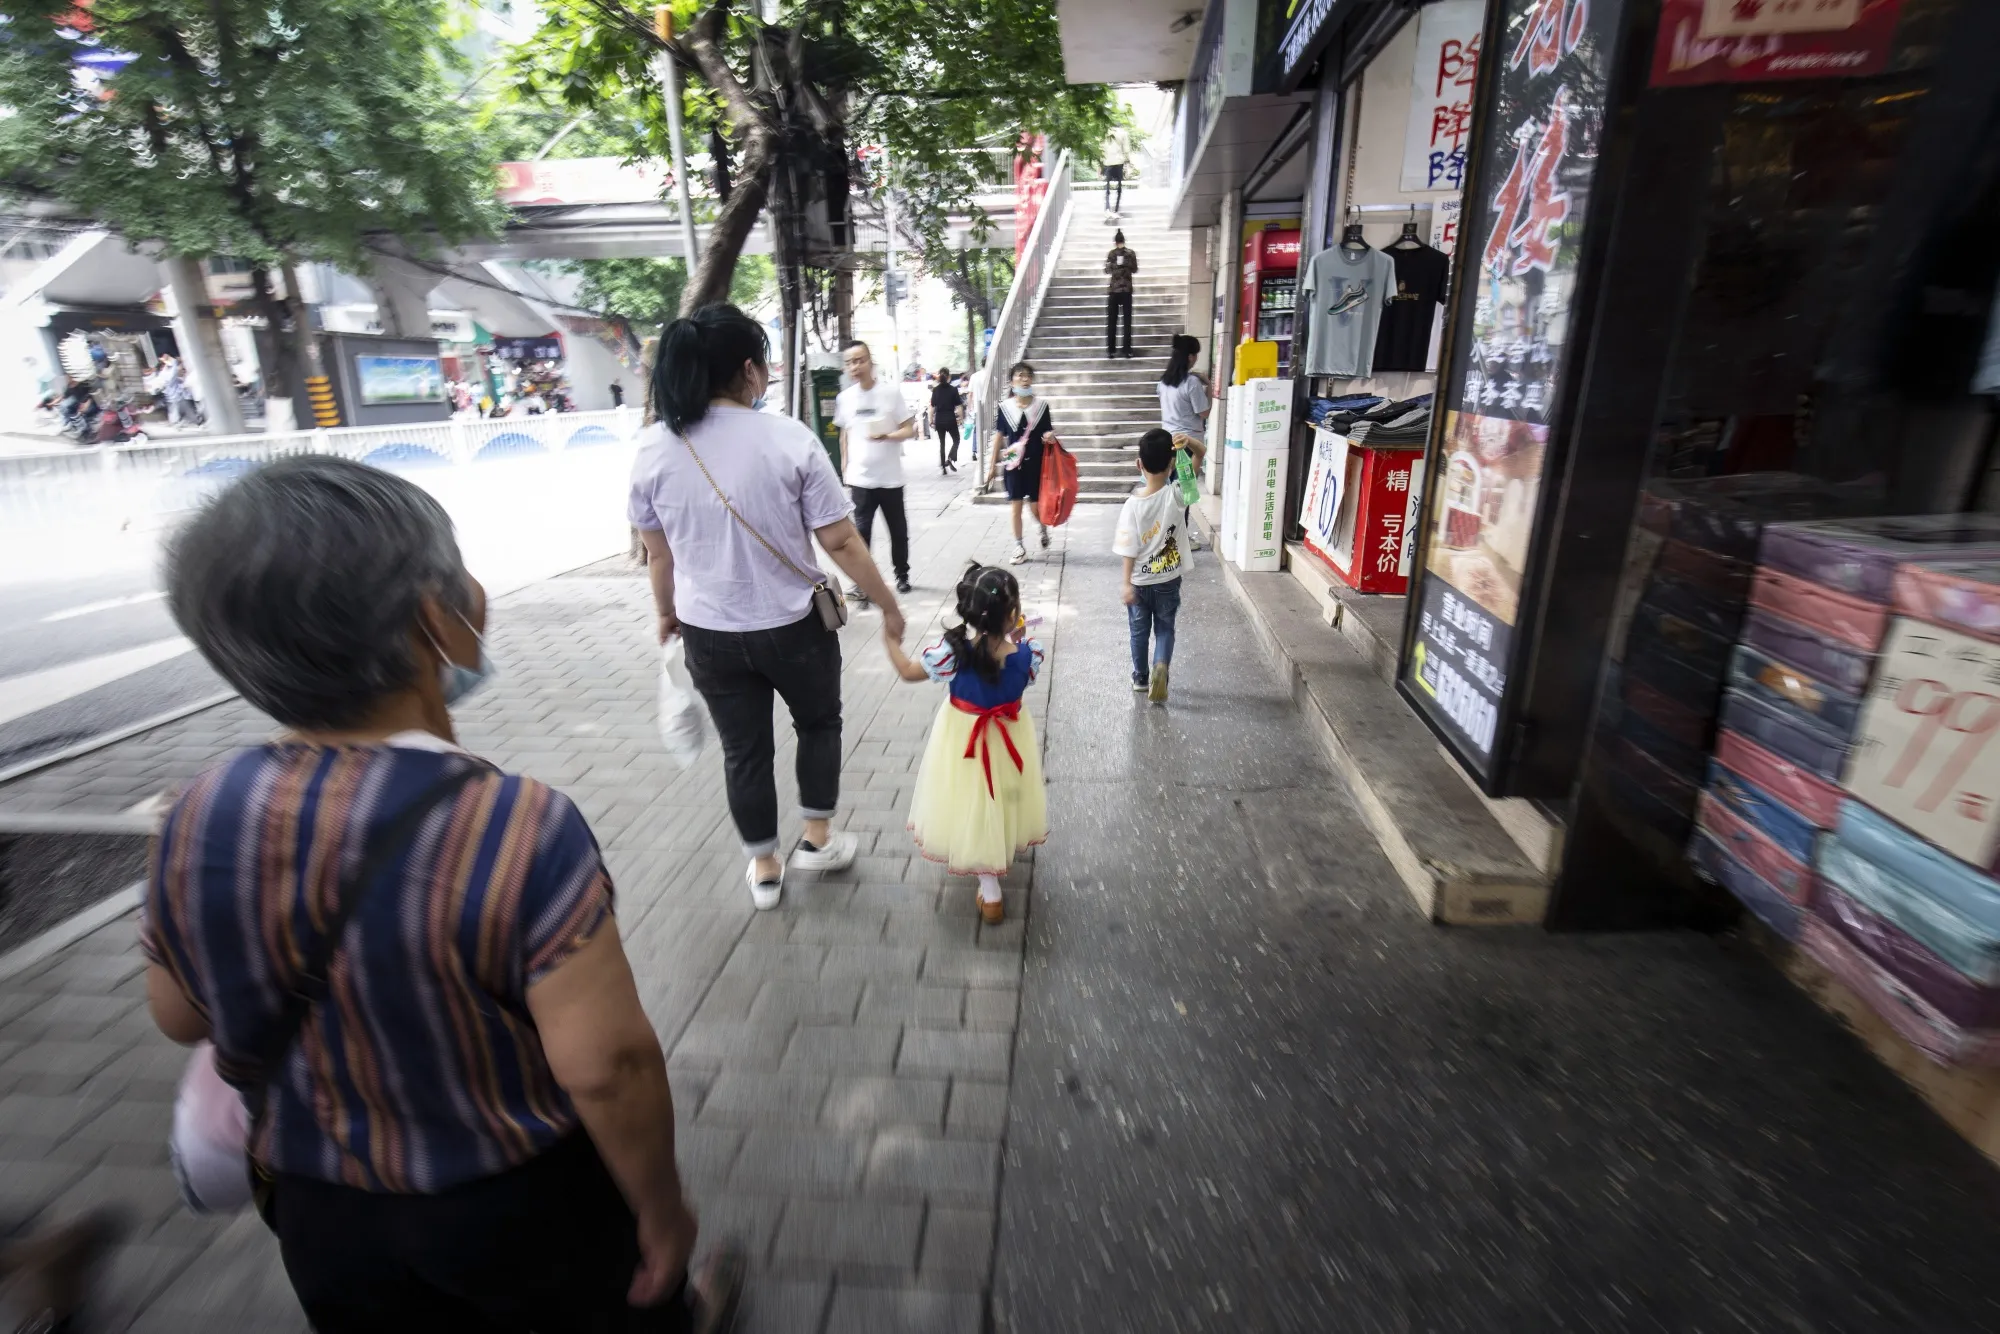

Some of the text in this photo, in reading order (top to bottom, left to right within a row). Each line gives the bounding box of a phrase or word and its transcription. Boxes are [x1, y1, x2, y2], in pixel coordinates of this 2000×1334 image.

[1263, 458, 1277, 541] 用小电 生活不断电
[1376, 469, 1410, 573] 精 亏本价
[1441, 591, 1494, 651] 营业时间
